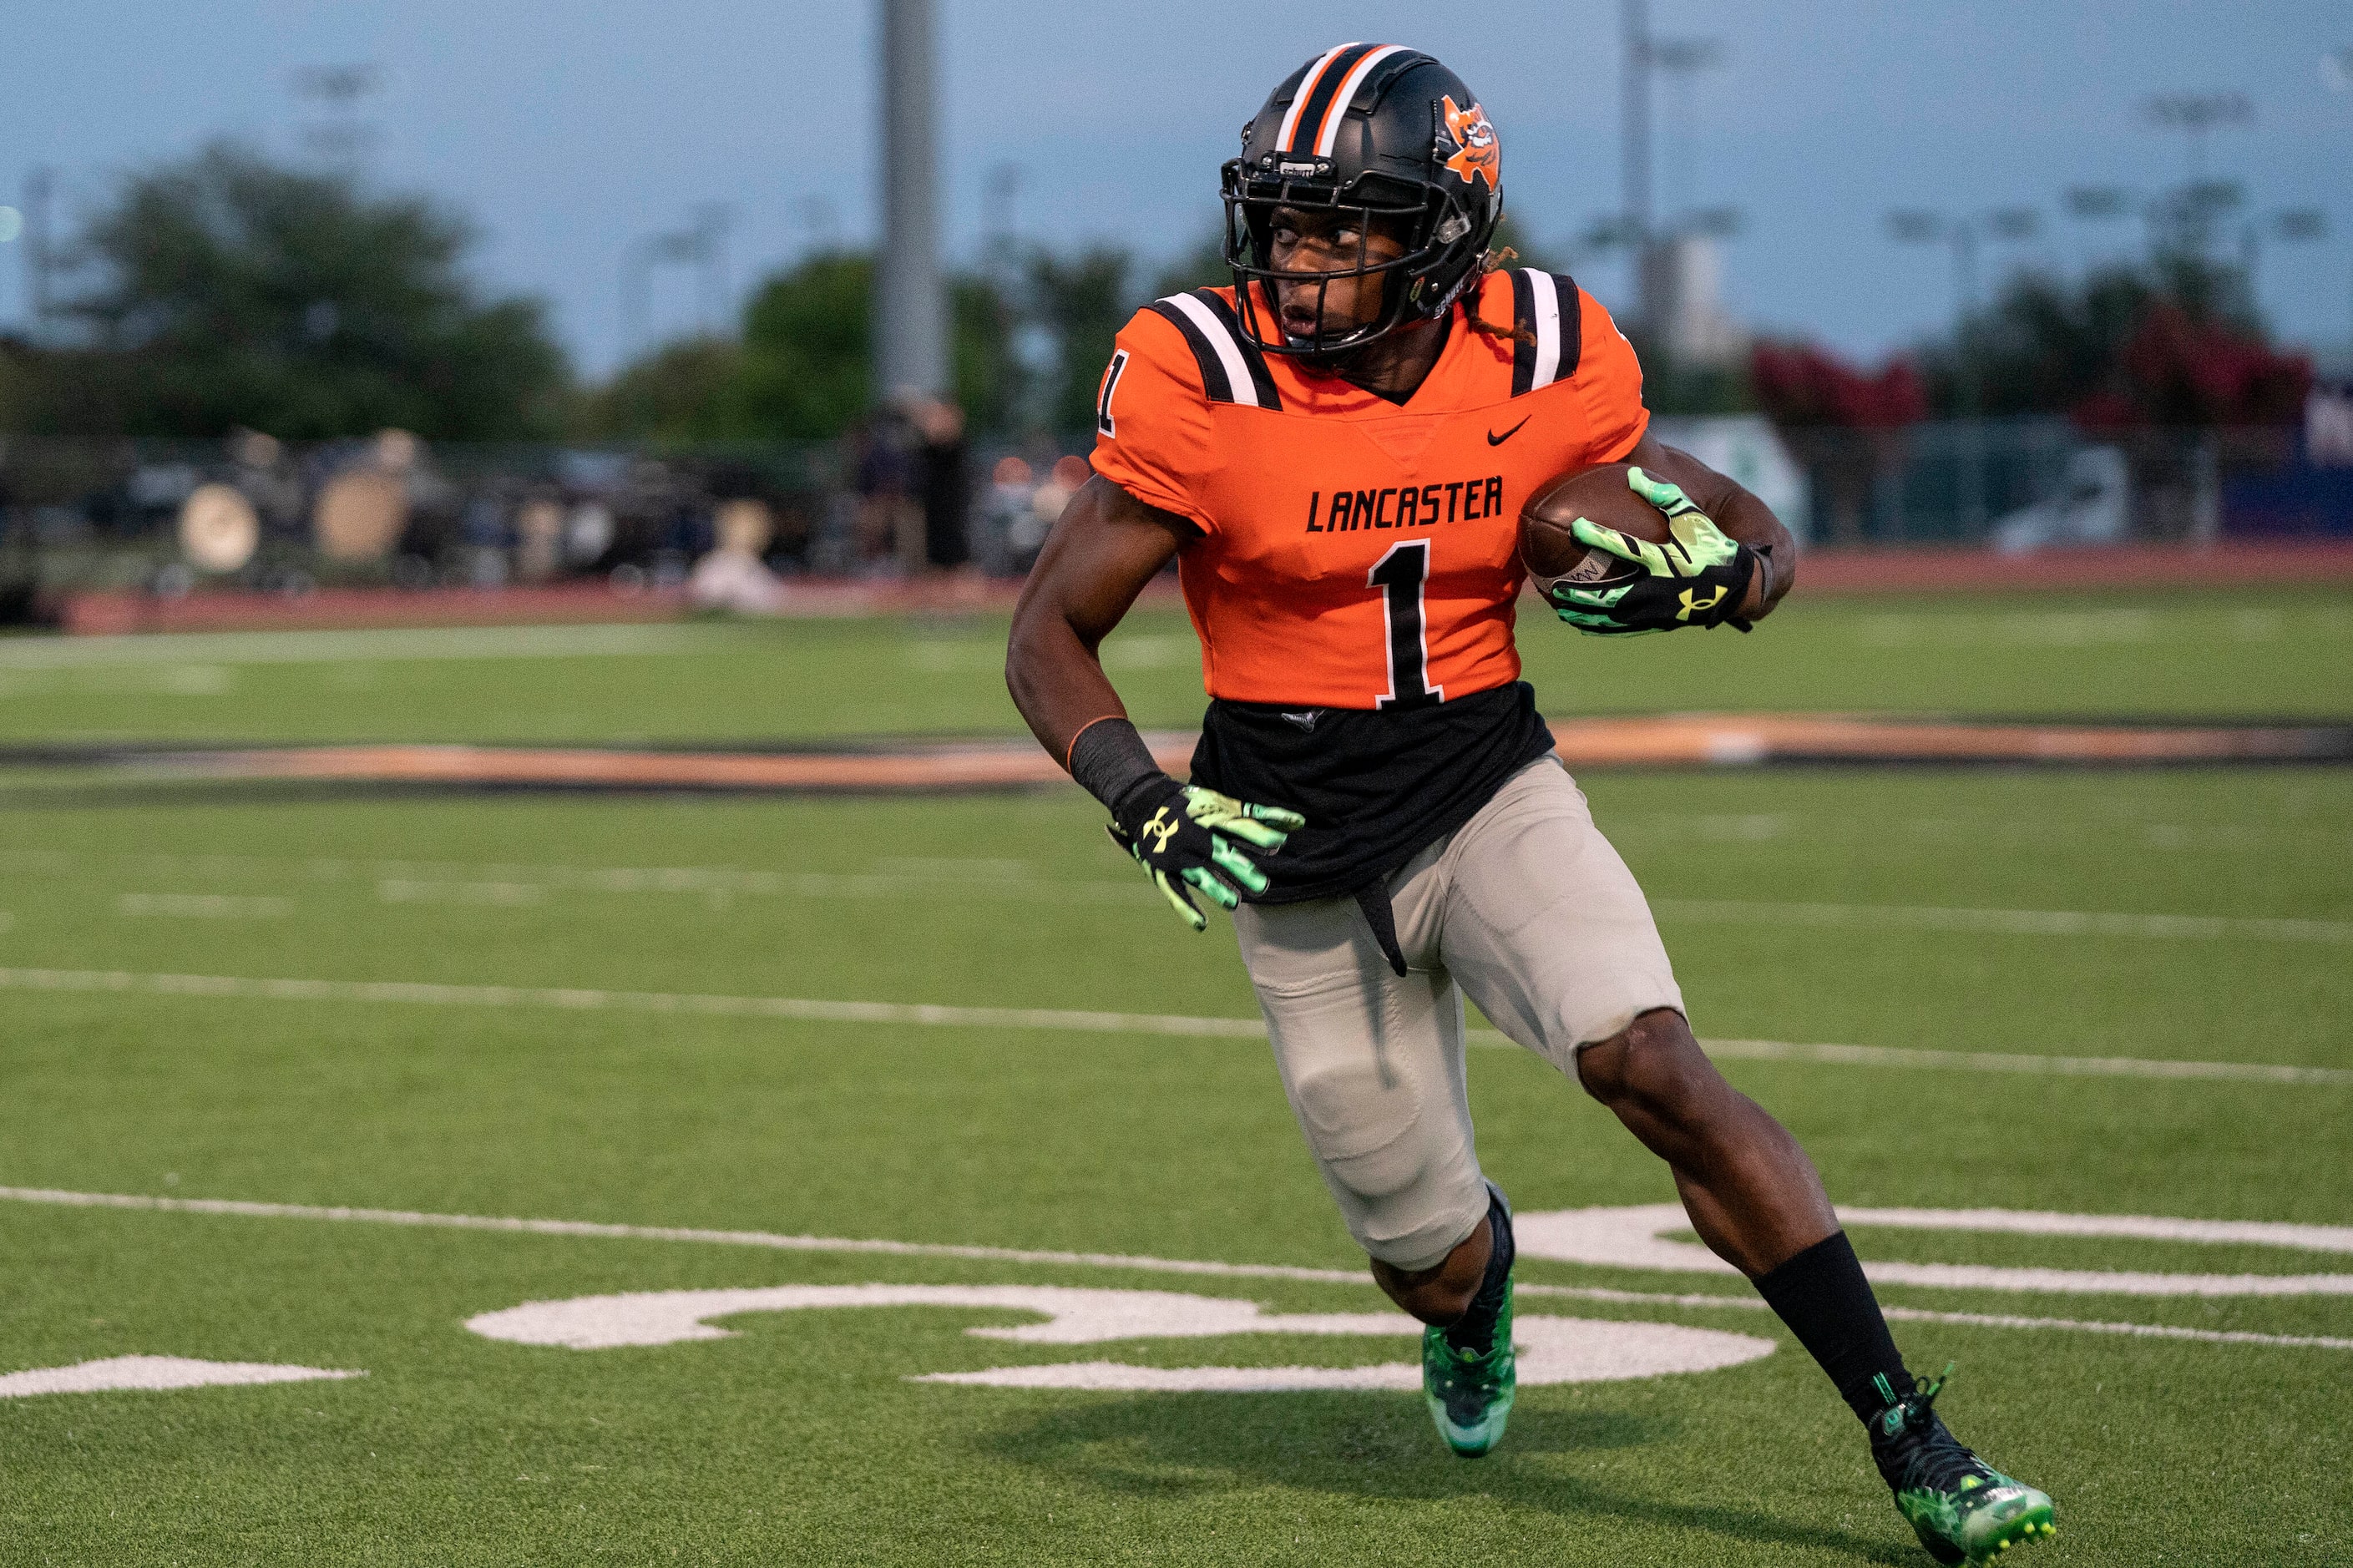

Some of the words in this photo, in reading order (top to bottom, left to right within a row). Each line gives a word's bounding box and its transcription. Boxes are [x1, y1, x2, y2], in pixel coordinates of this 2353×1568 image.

[1098, 348, 1131, 439] 1
[1306, 475, 1503, 533] LANCASTER
[1366, 538, 1445, 711] 1
